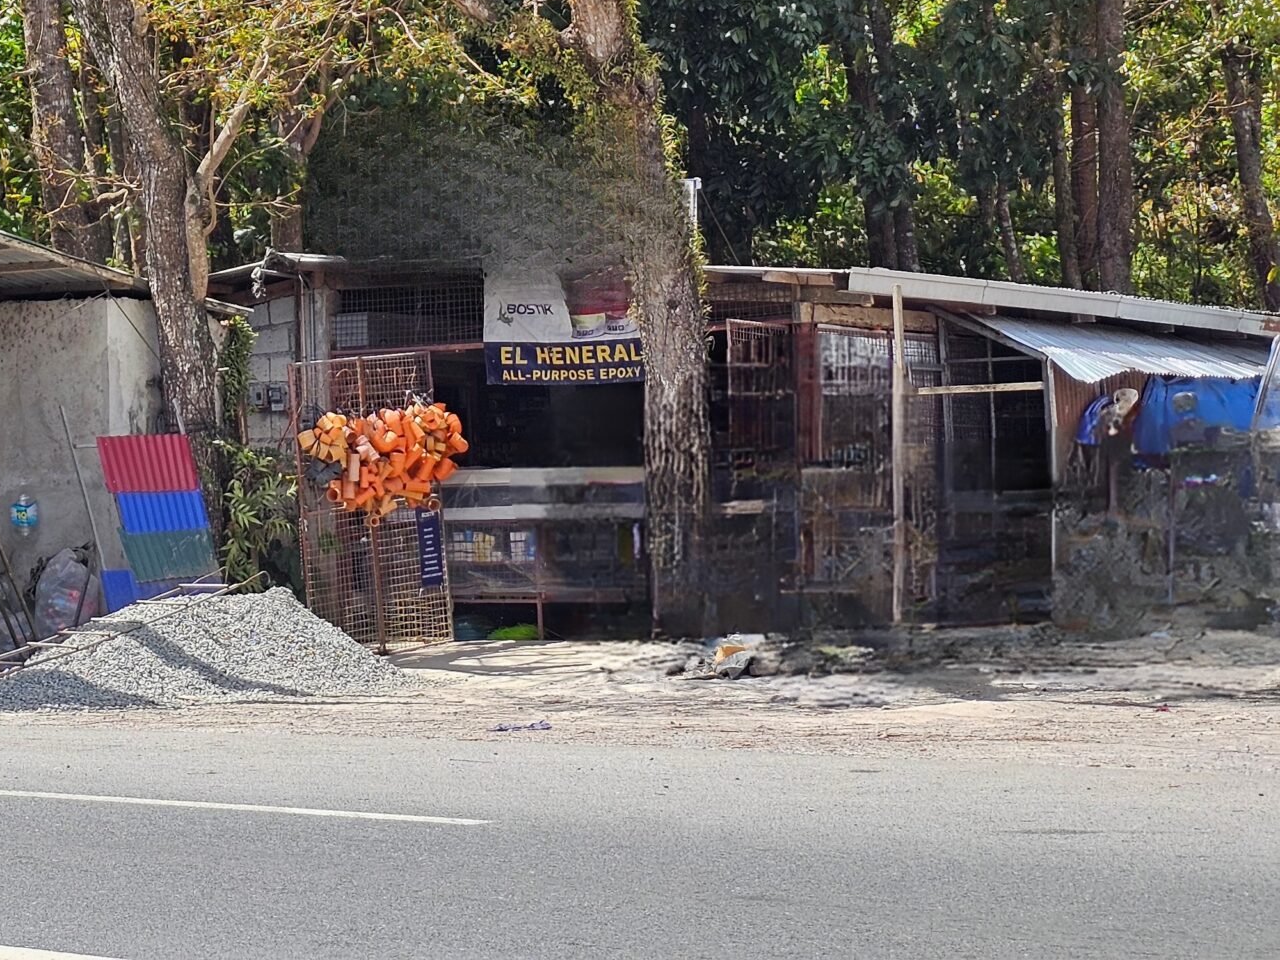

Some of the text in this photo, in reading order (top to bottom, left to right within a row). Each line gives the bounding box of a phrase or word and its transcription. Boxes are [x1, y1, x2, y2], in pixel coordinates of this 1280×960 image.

[507, 303, 554, 315] BOSTIK
[500, 344, 642, 365] EL HENERAL
[502, 366, 641, 381] ALL-PURPOSE EPOXY
